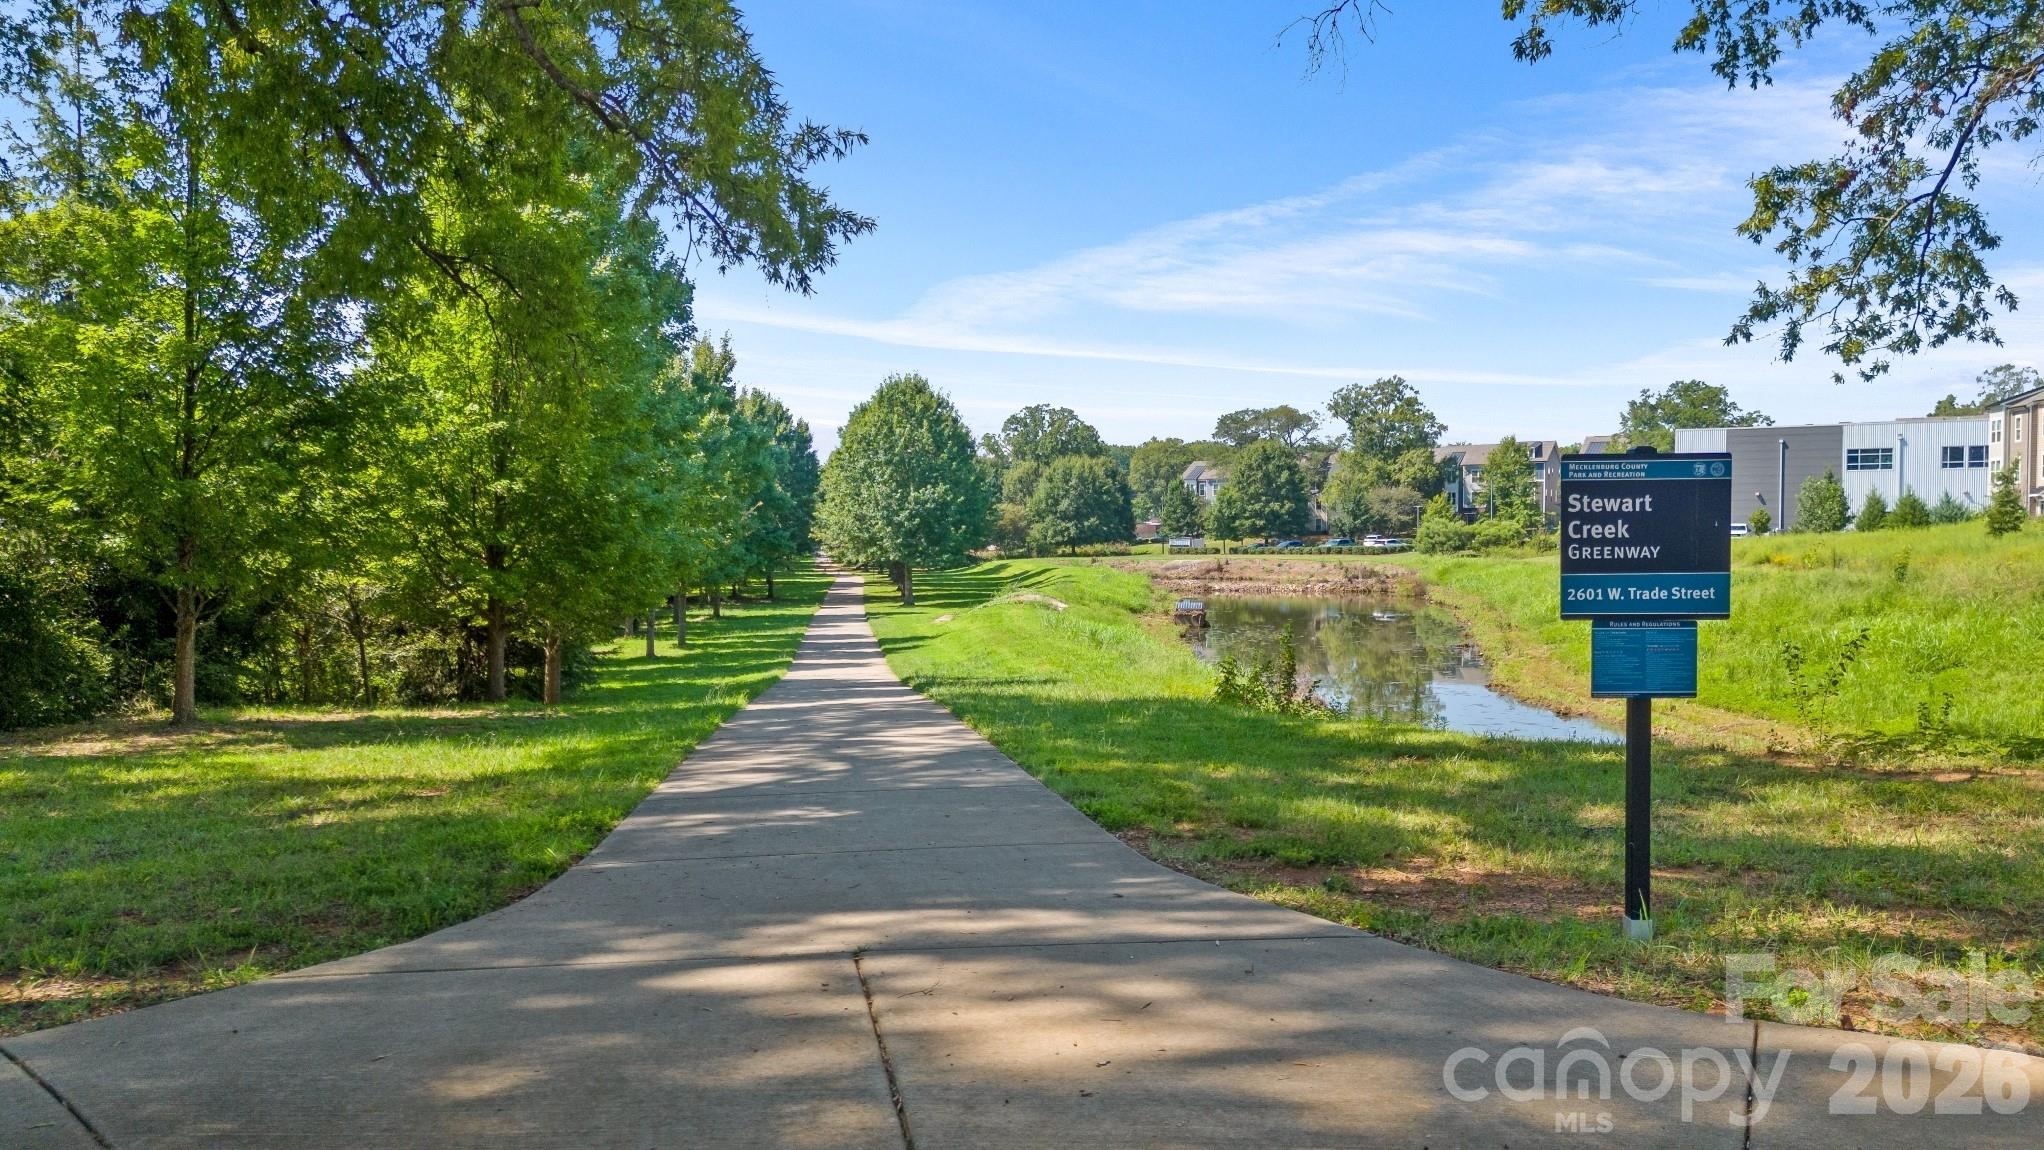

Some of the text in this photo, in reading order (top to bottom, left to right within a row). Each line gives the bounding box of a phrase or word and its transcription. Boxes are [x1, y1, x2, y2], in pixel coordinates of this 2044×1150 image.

[1621, 462, 1648, 470] COUNTY
[1567, 494, 1652, 512] Stewart
[1568, 520, 1630, 538] Creek
[1568, 544, 1660, 559] GREENWAY
[1567, 587, 1715, 600] 2601 W. Trade Street
